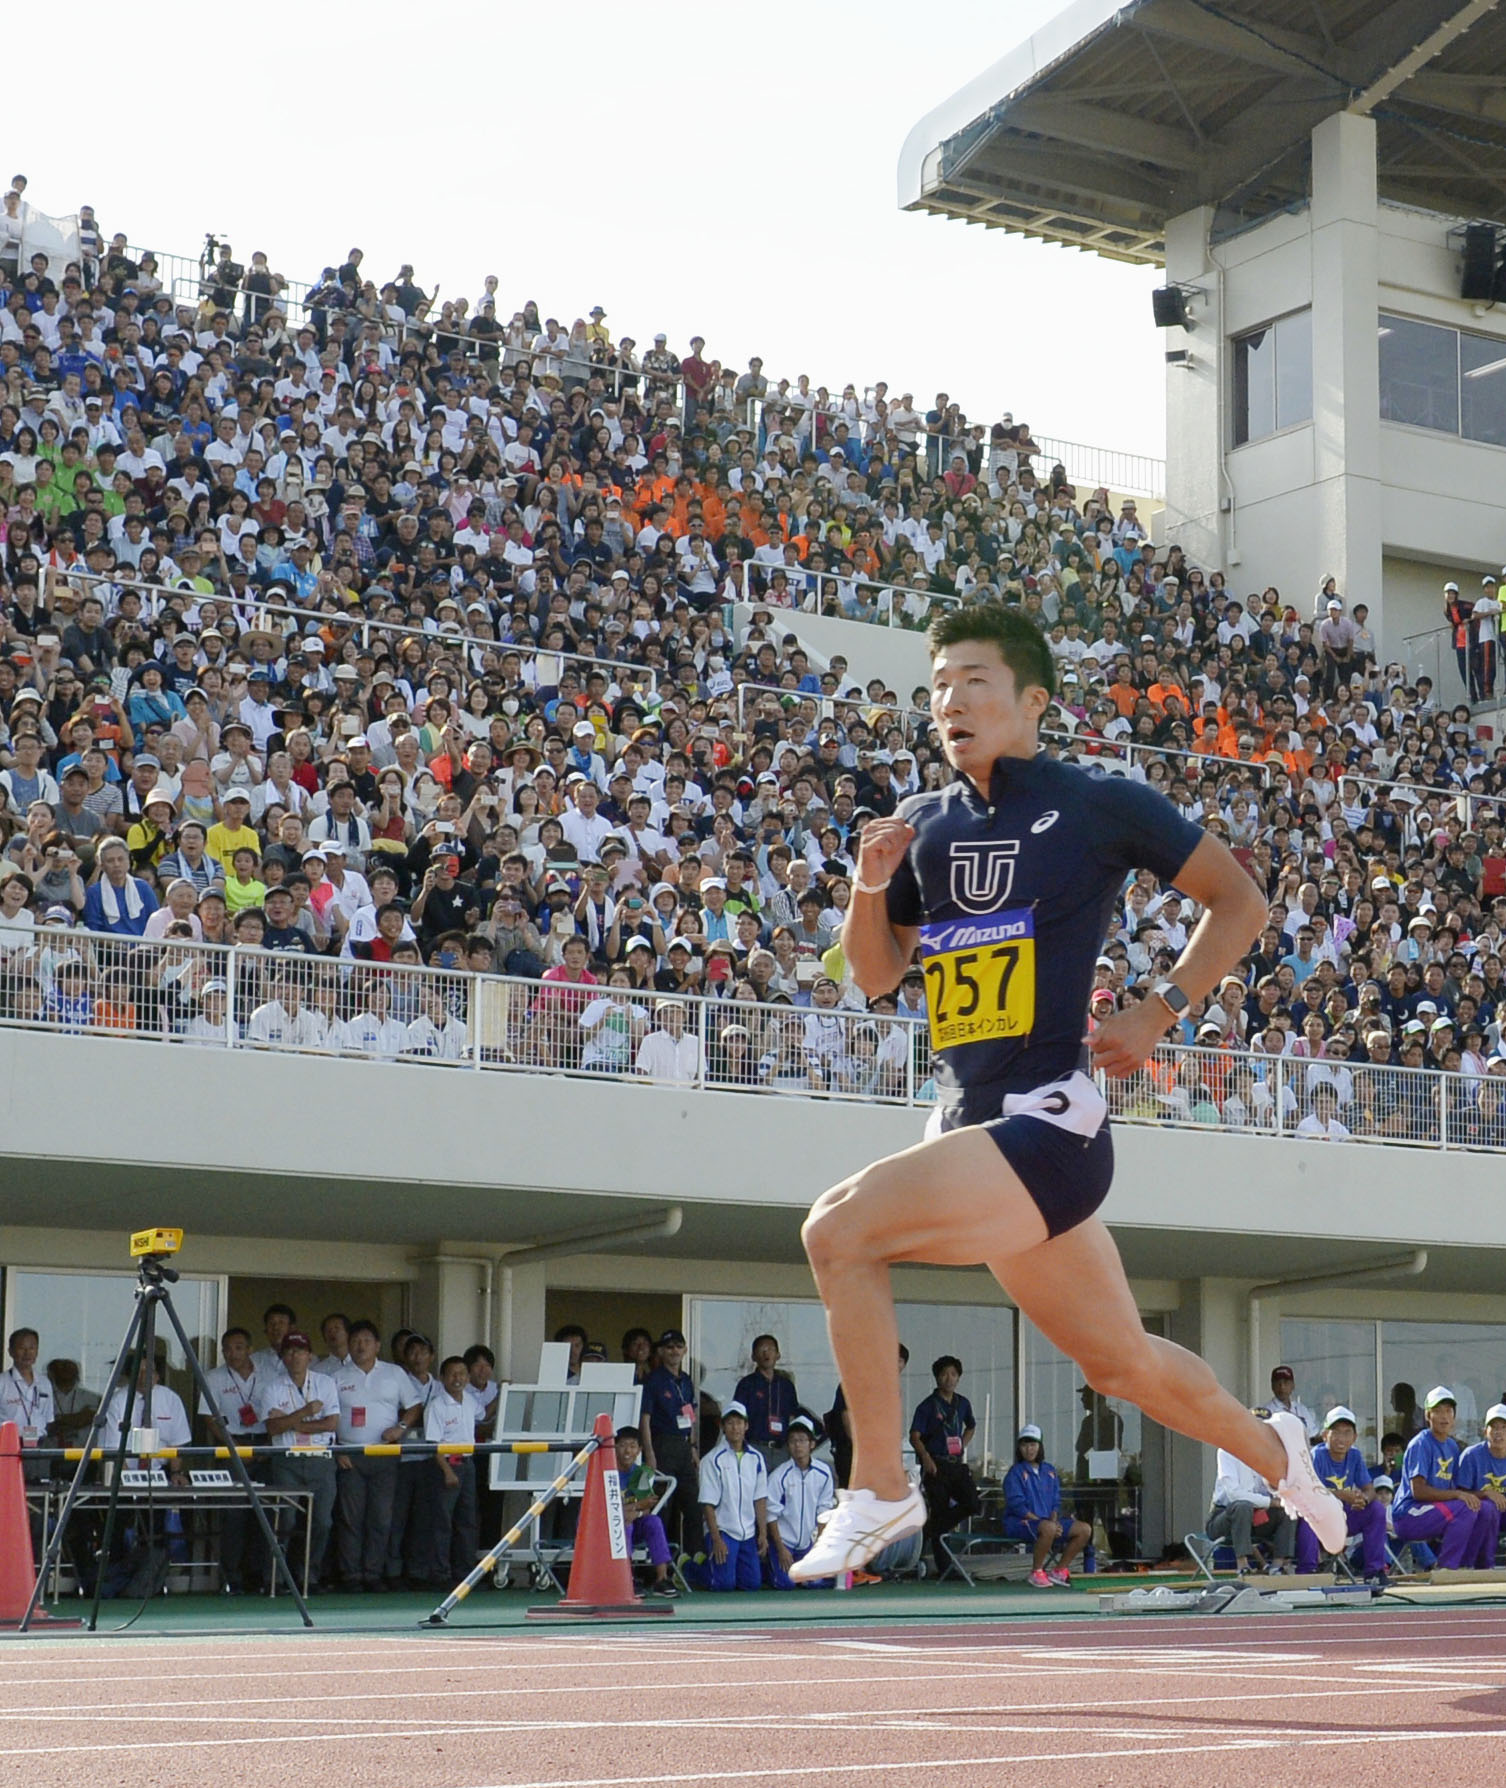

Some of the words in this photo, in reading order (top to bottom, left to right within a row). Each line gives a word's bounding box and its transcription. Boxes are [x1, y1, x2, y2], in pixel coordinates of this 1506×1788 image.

[926, 946, 1019, 1023] 257
[607, 1474, 625, 1554] 福井マラソン
